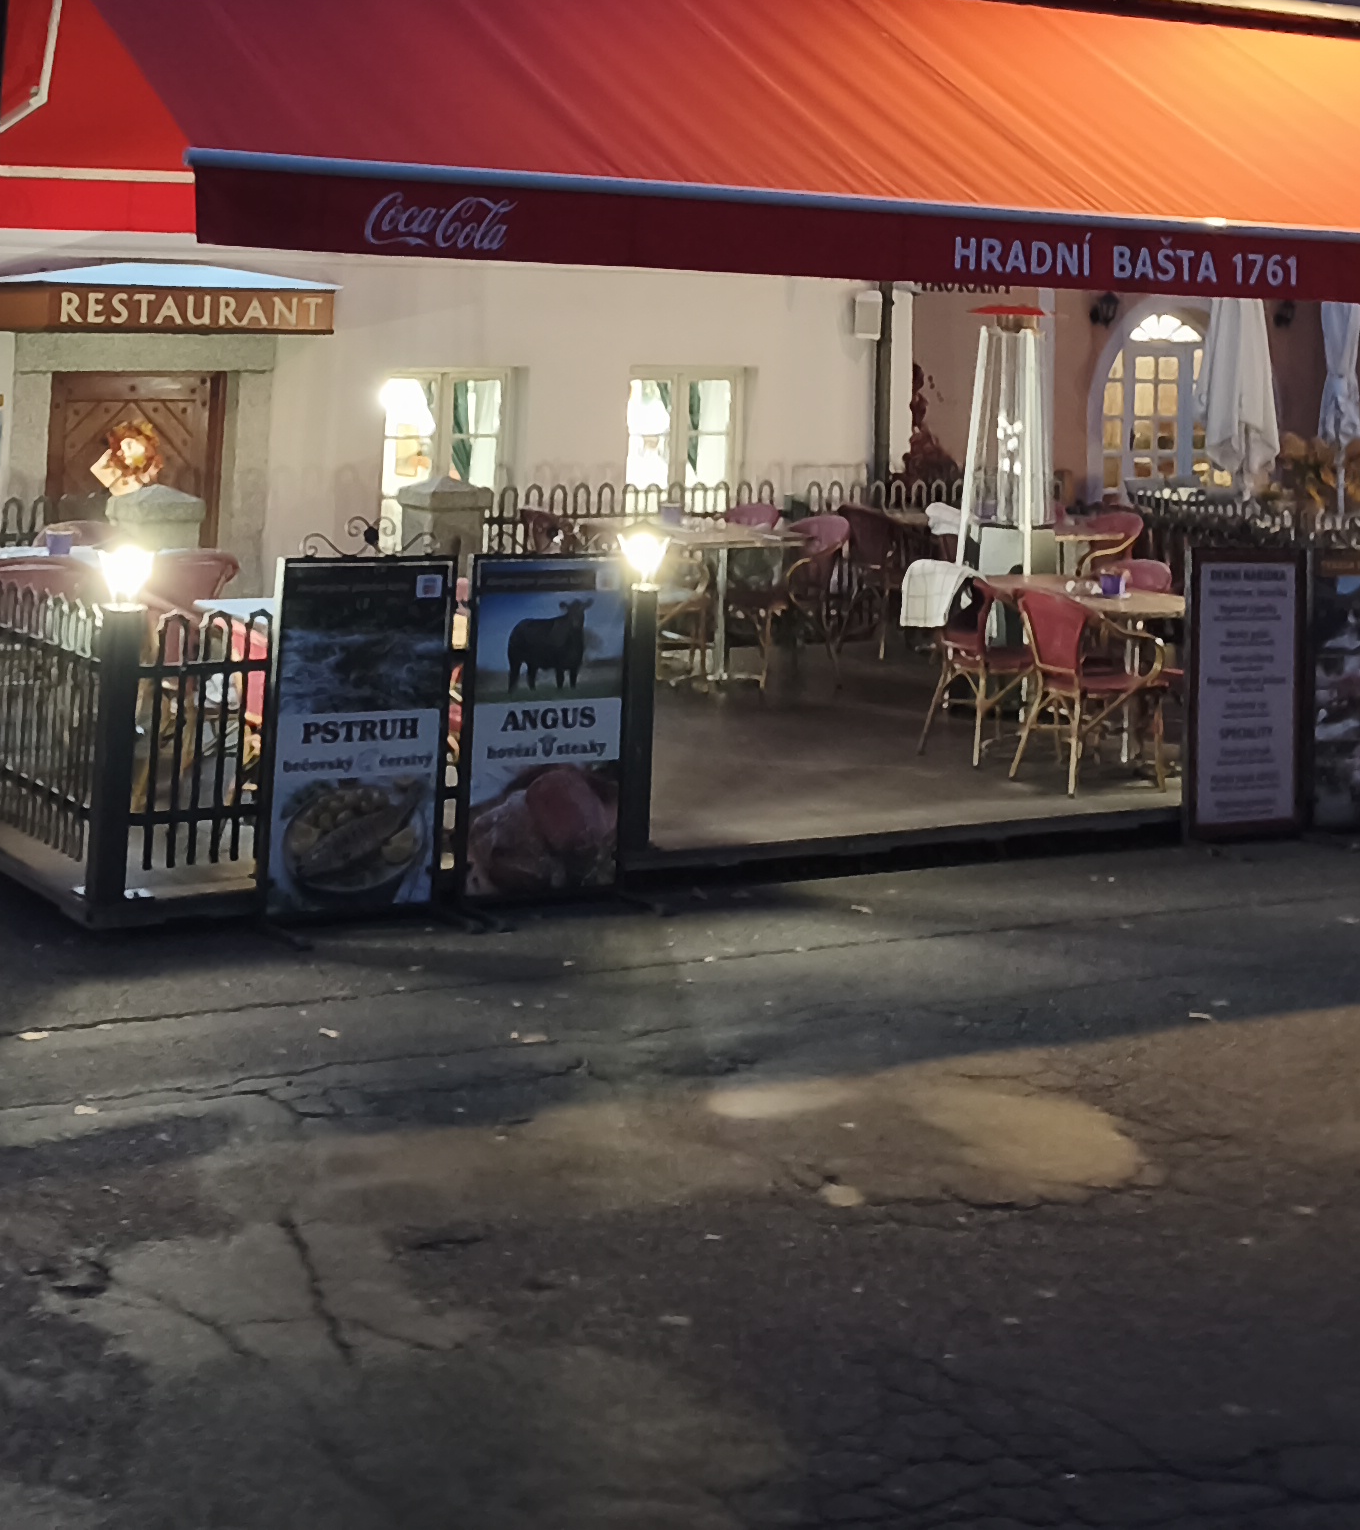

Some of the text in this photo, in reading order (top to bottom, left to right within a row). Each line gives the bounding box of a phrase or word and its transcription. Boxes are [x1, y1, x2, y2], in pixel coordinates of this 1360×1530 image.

[364, 191, 518, 250] Coca-Cola
[954, 233, 1299, 287] HRADNÍ BAŠTA 1761
[58, 291, 324, 328] RESTAURANT
[301, 716, 420, 745] PSTRUH
[501, 706, 597, 732] ANGUS
